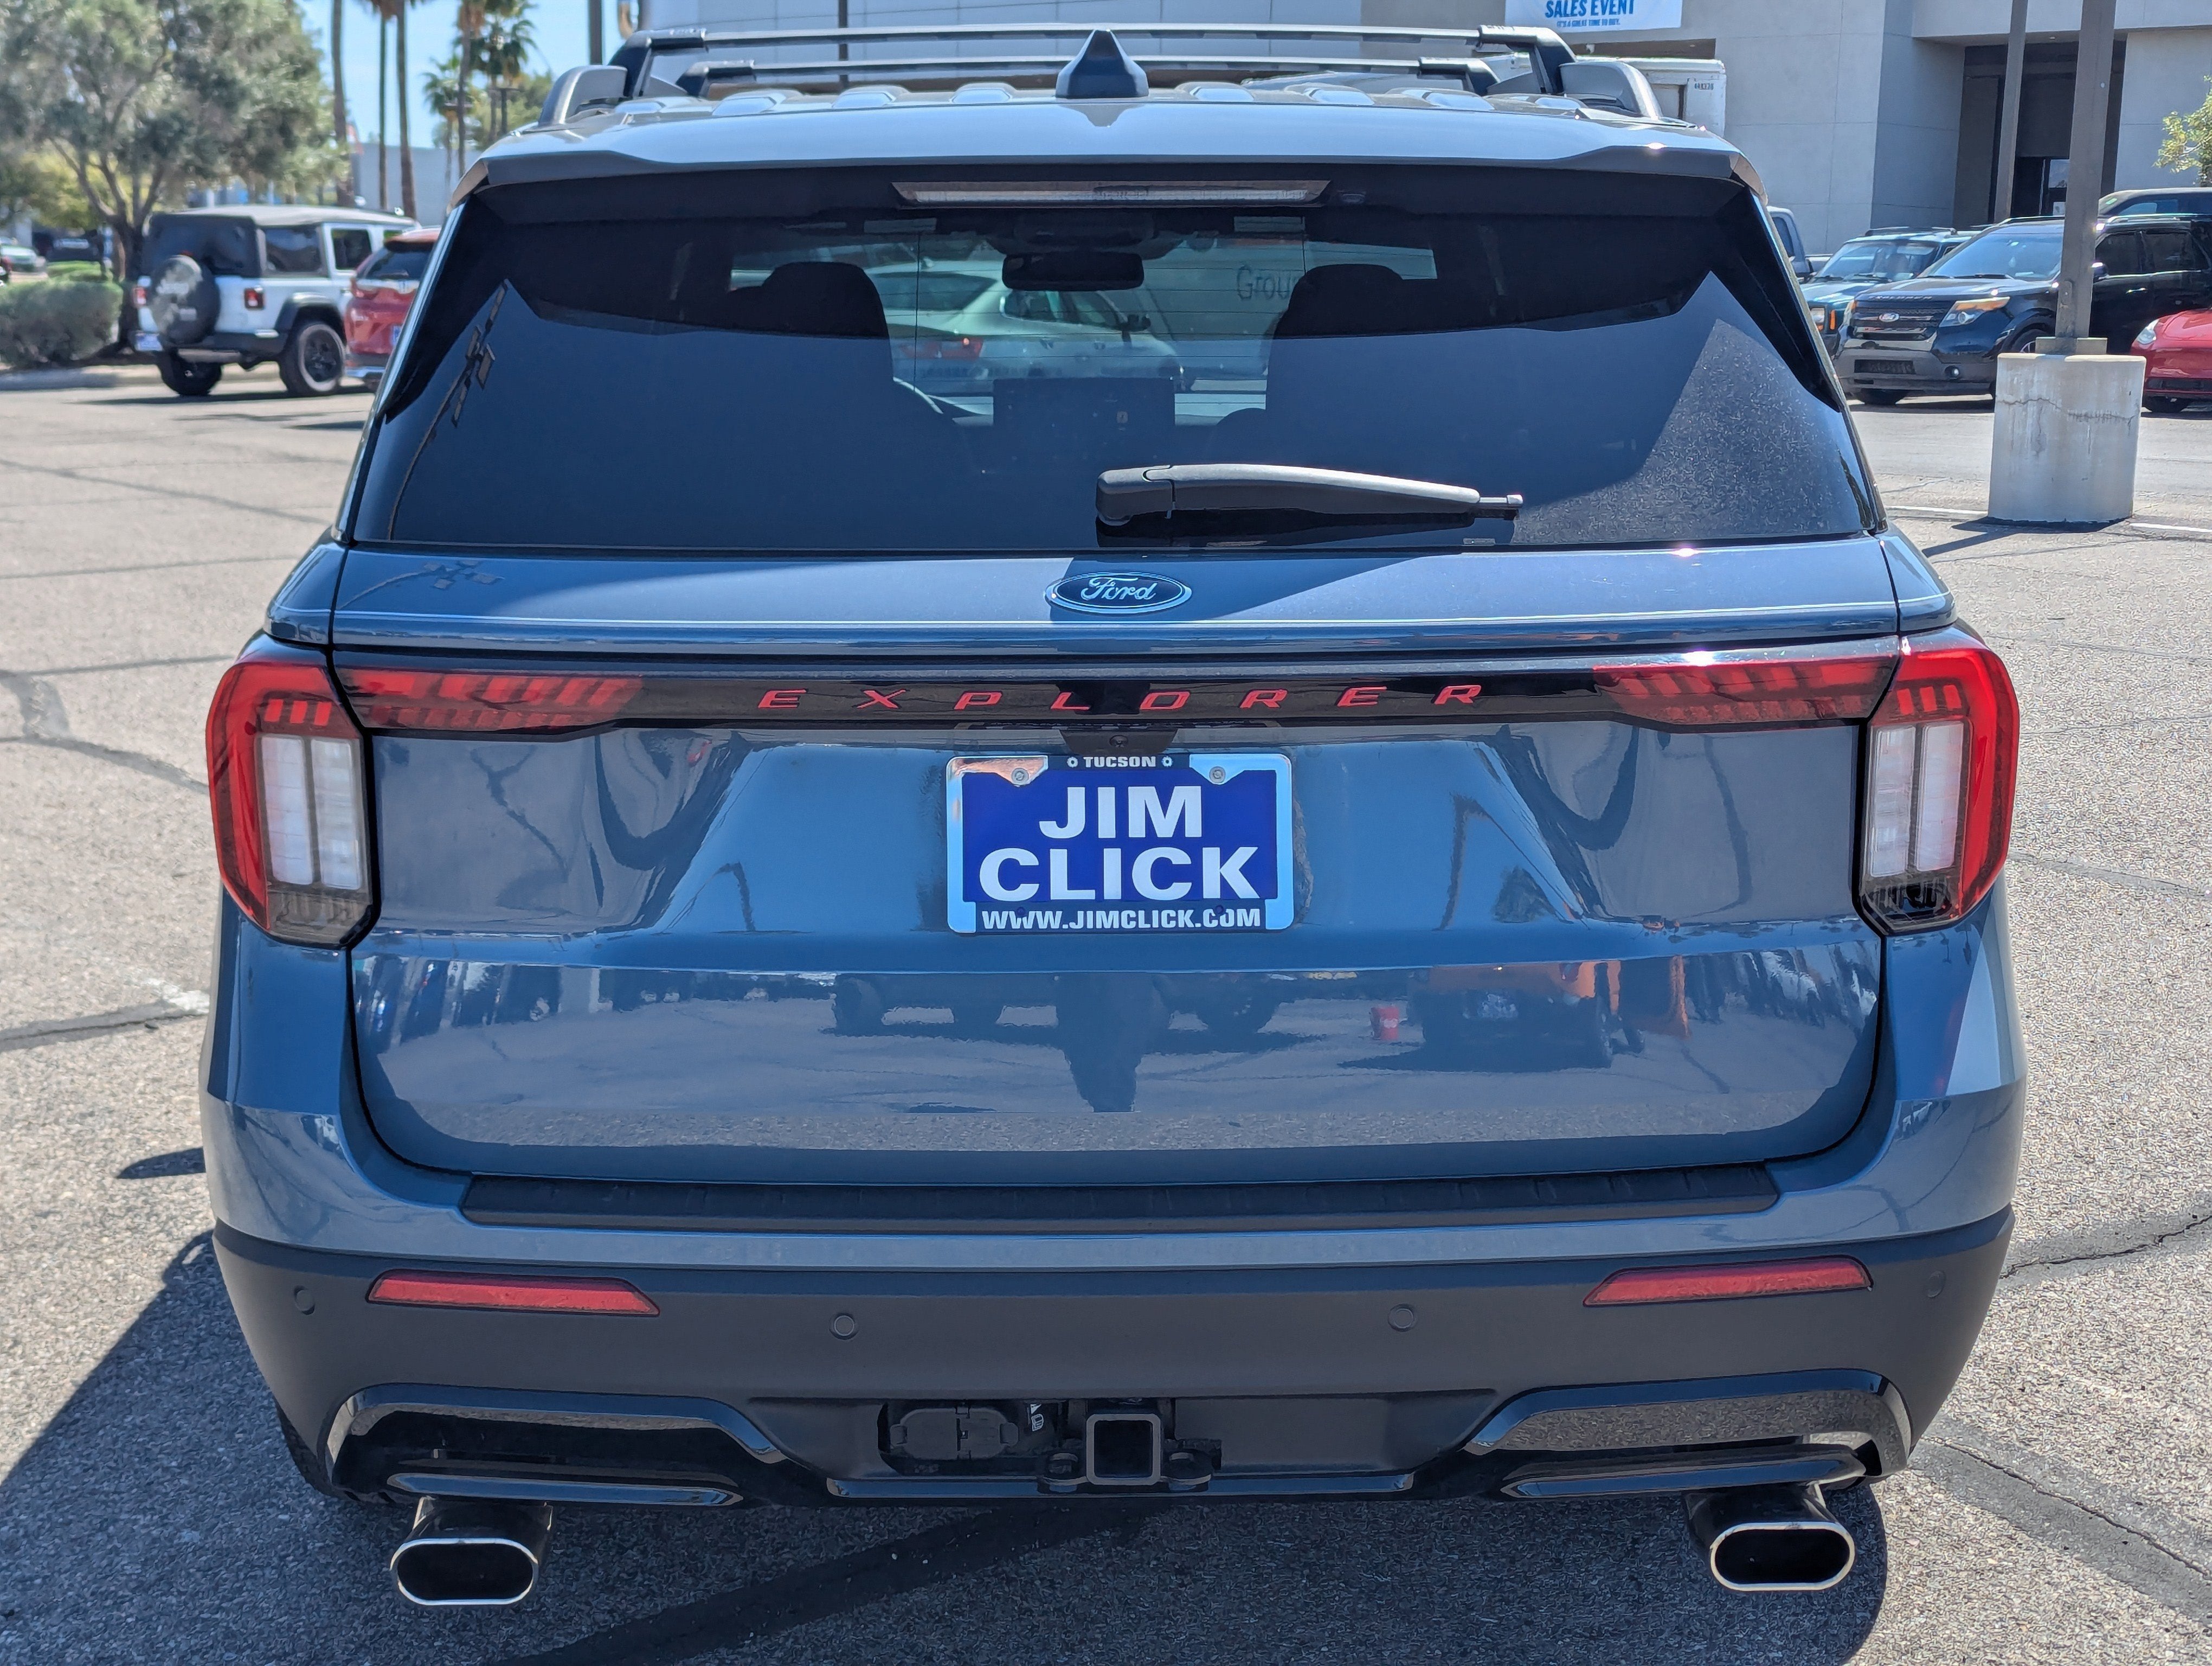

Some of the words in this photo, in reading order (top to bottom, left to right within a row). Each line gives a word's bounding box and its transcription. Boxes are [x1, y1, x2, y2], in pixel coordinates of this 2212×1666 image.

[1545, 0, 1587, 18] SALES
[1590, 0, 1634, 16] EVENT
[1237, 264, 1298, 300] Grou
[1081, 577, 1158, 600] Ford
[757, 684, 1482, 709] EXPLORER
[1083, 756, 1156, 768] TUCSON
[1039, 786, 1202, 839] JIM
[979, 847, 1261, 902] CLICK
[981, 908, 1261, 930] WWW.JIMCLICK.COM
